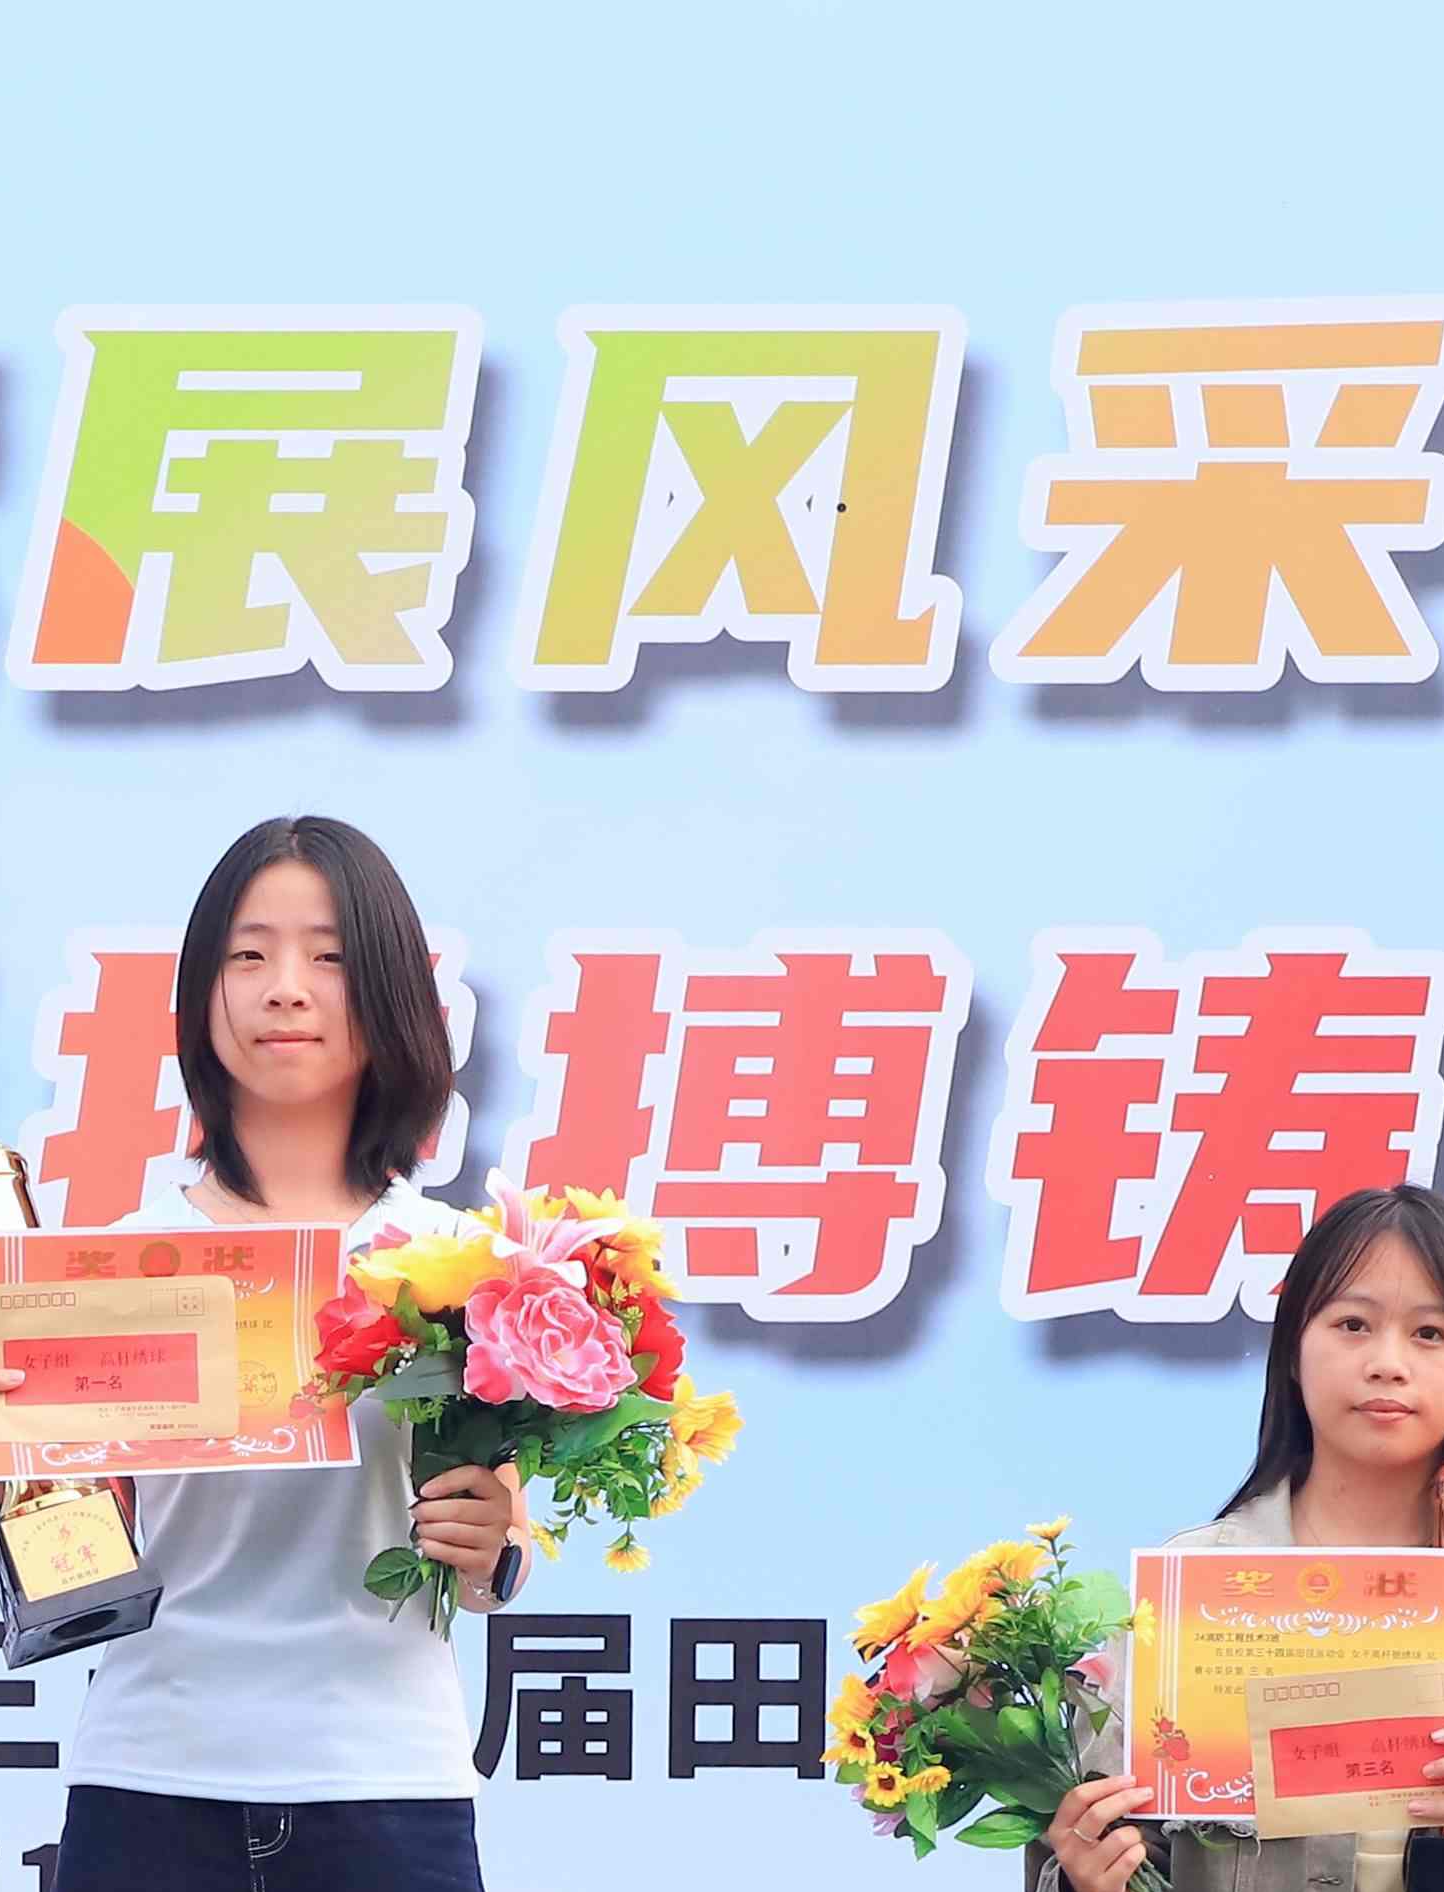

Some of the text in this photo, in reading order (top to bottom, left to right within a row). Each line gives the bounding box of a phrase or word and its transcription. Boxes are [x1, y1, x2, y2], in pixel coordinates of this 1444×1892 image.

[203, 1246, 255, 1271] 状
[74, 1374, 123, 1392] 第一名
[1225, 1570, 1418, 1598] 奖 状
[1345, 1760, 1395, 1779] 第三名
